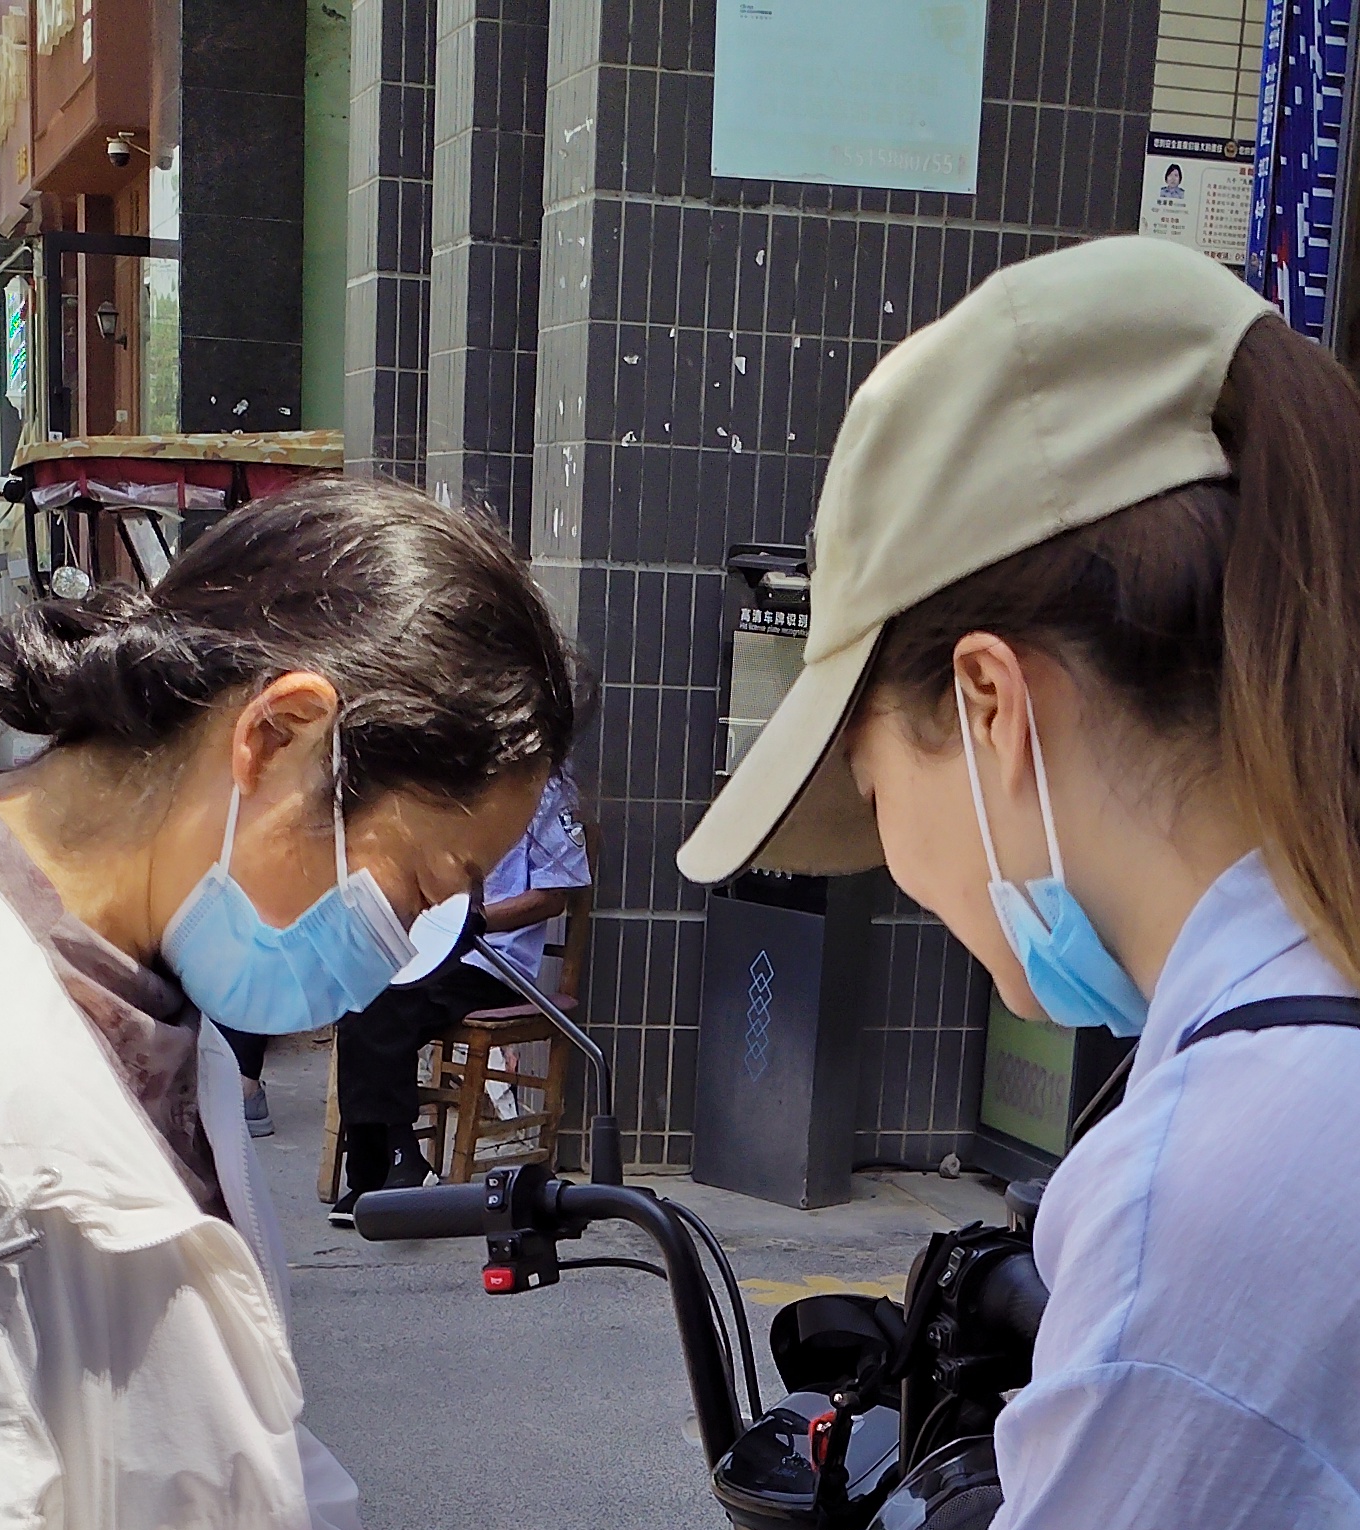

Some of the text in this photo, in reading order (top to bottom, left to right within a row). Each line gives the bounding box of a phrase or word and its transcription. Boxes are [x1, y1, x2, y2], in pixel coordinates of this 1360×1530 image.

[740, 607, 809, 628] 高清车牌识别
